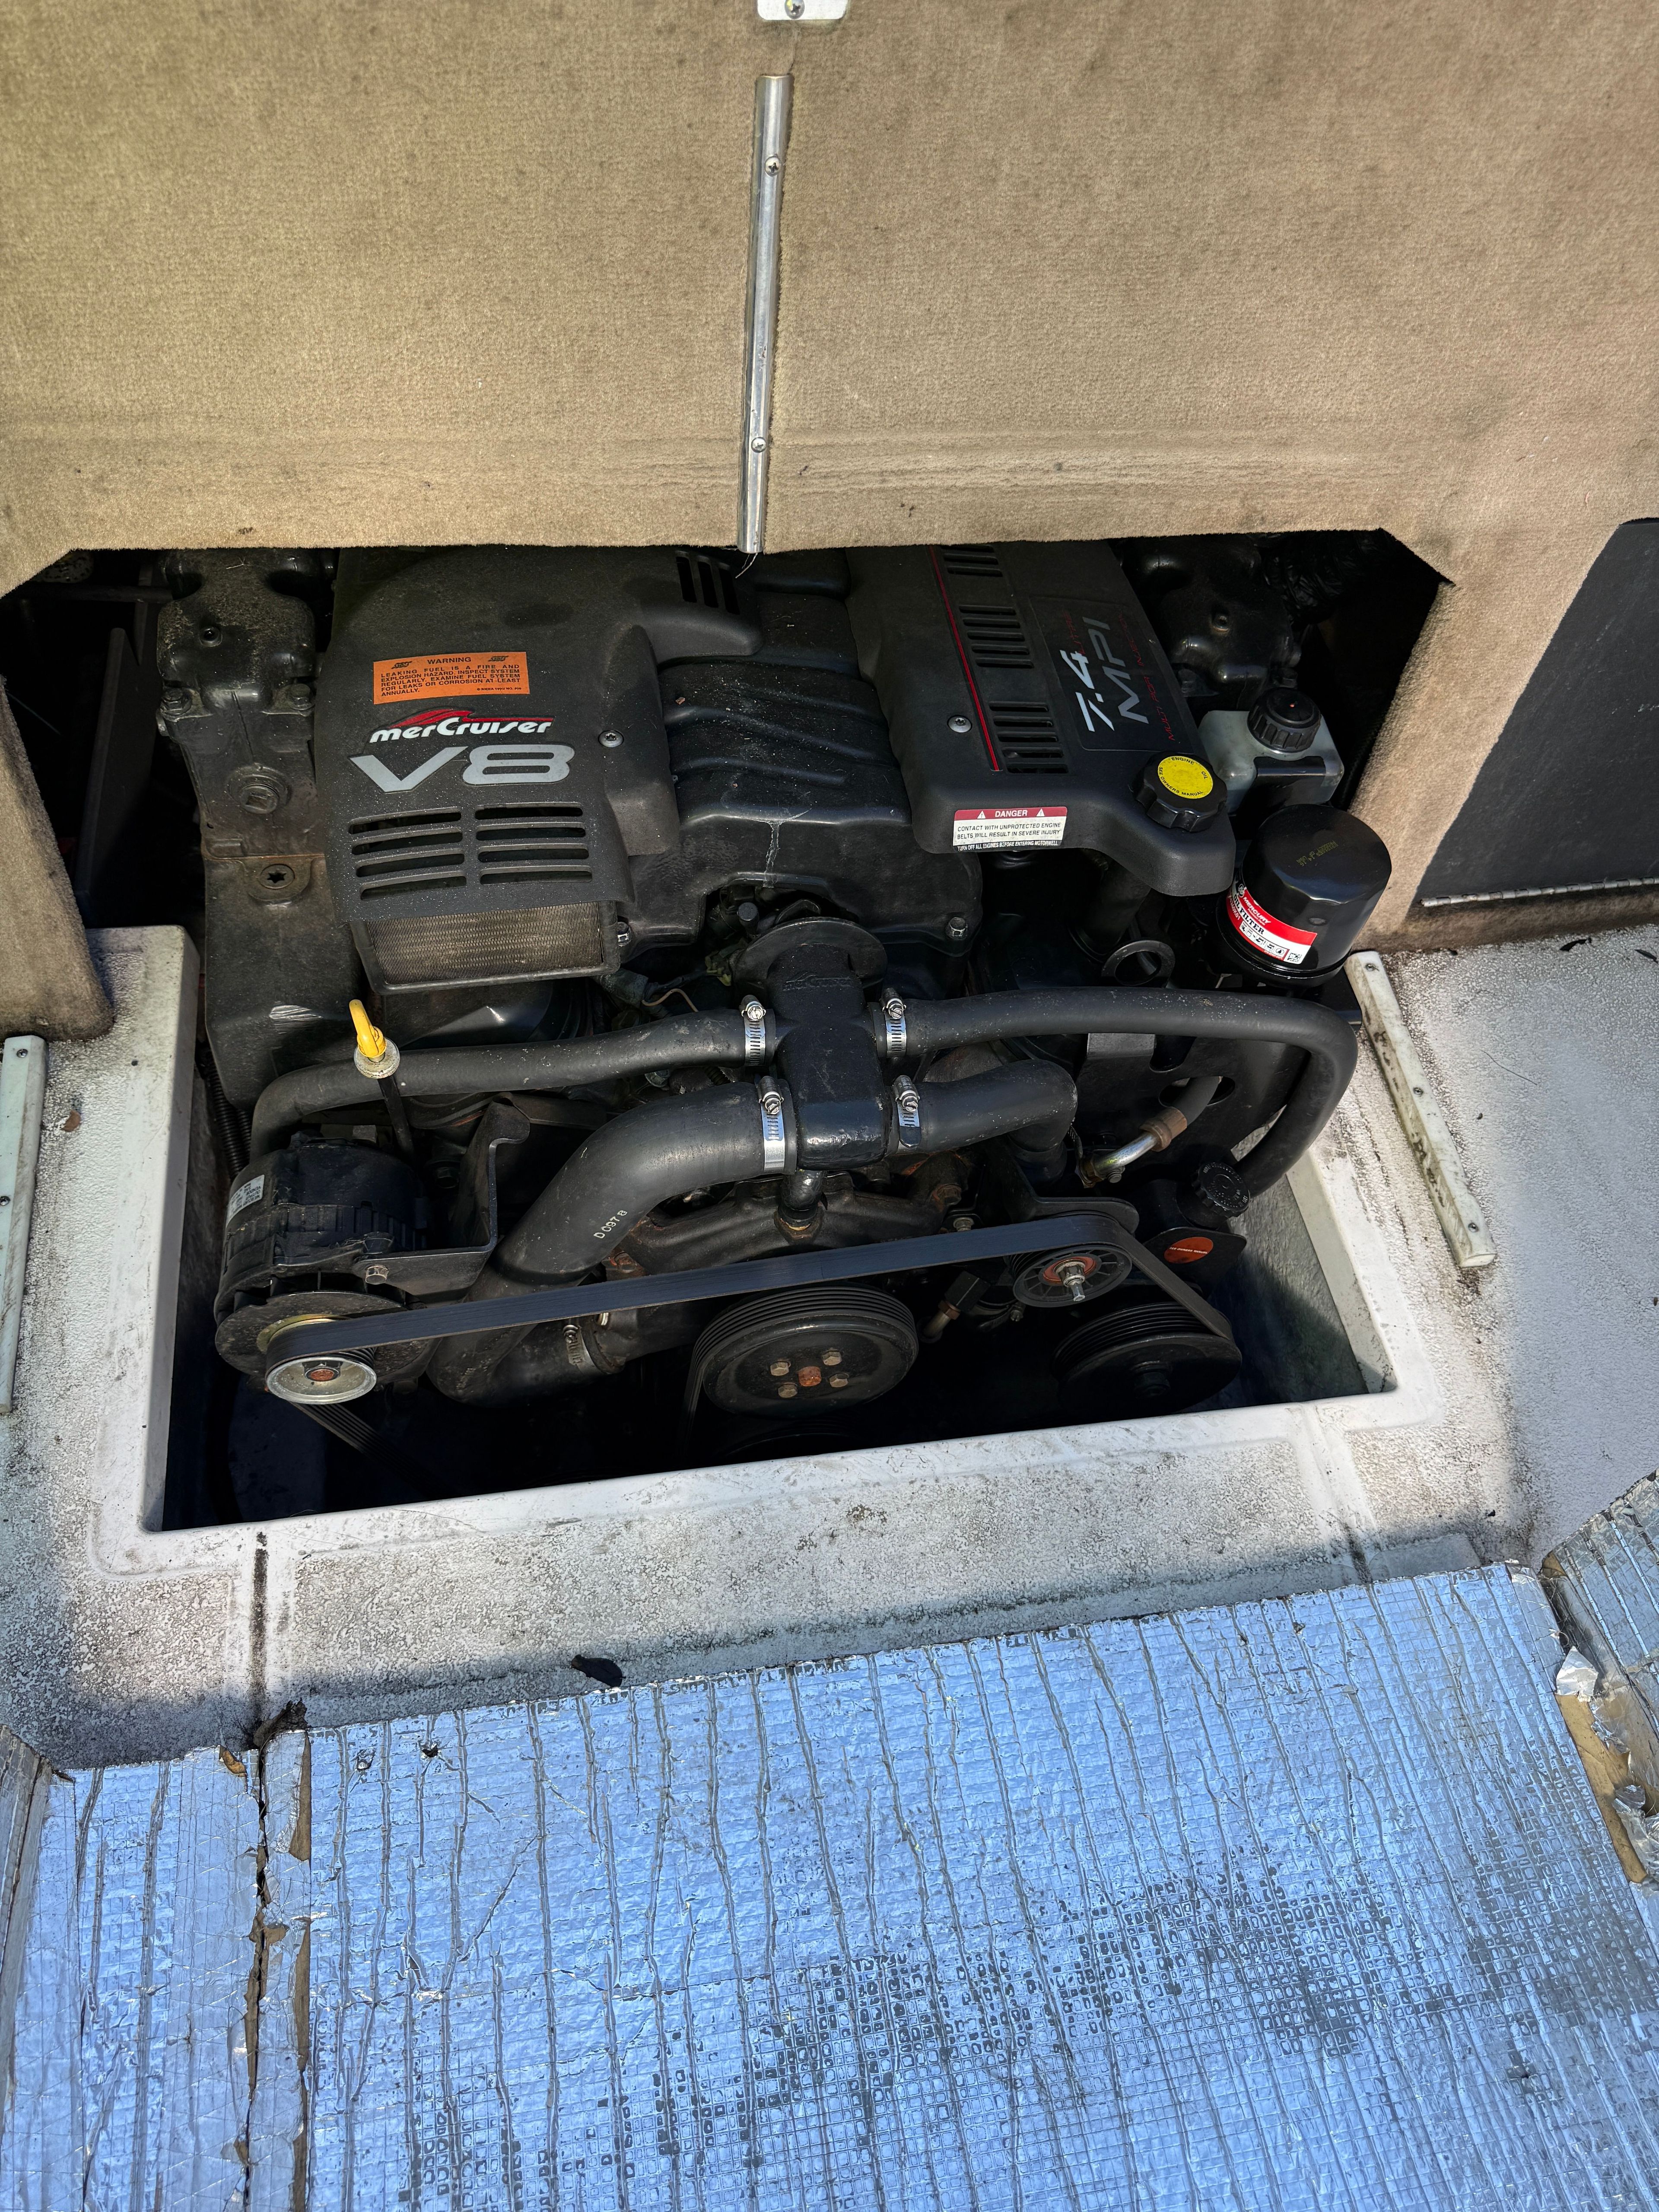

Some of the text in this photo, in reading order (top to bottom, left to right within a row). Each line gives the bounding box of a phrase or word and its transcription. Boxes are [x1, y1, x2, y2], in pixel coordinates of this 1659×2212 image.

[381, 674, 421, 682] EXPLOSION
[381, 678, 426, 686] REGULARLY.
[1082, 617, 1149, 724] MPI
[381, 688, 420, 696] ANNUALLY.
[1059, 649, 1115, 732] 7.4
[369, 717, 552, 743] merCruiser
[1156, 706, 1175, 741] MULTI
[349, 744, 575, 792] V8
[1161, 776, 1179, 793] OWNERS
[1240, 907, 1264, 934] FILTER
[1243, 896, 1271, 924] MERCURY
